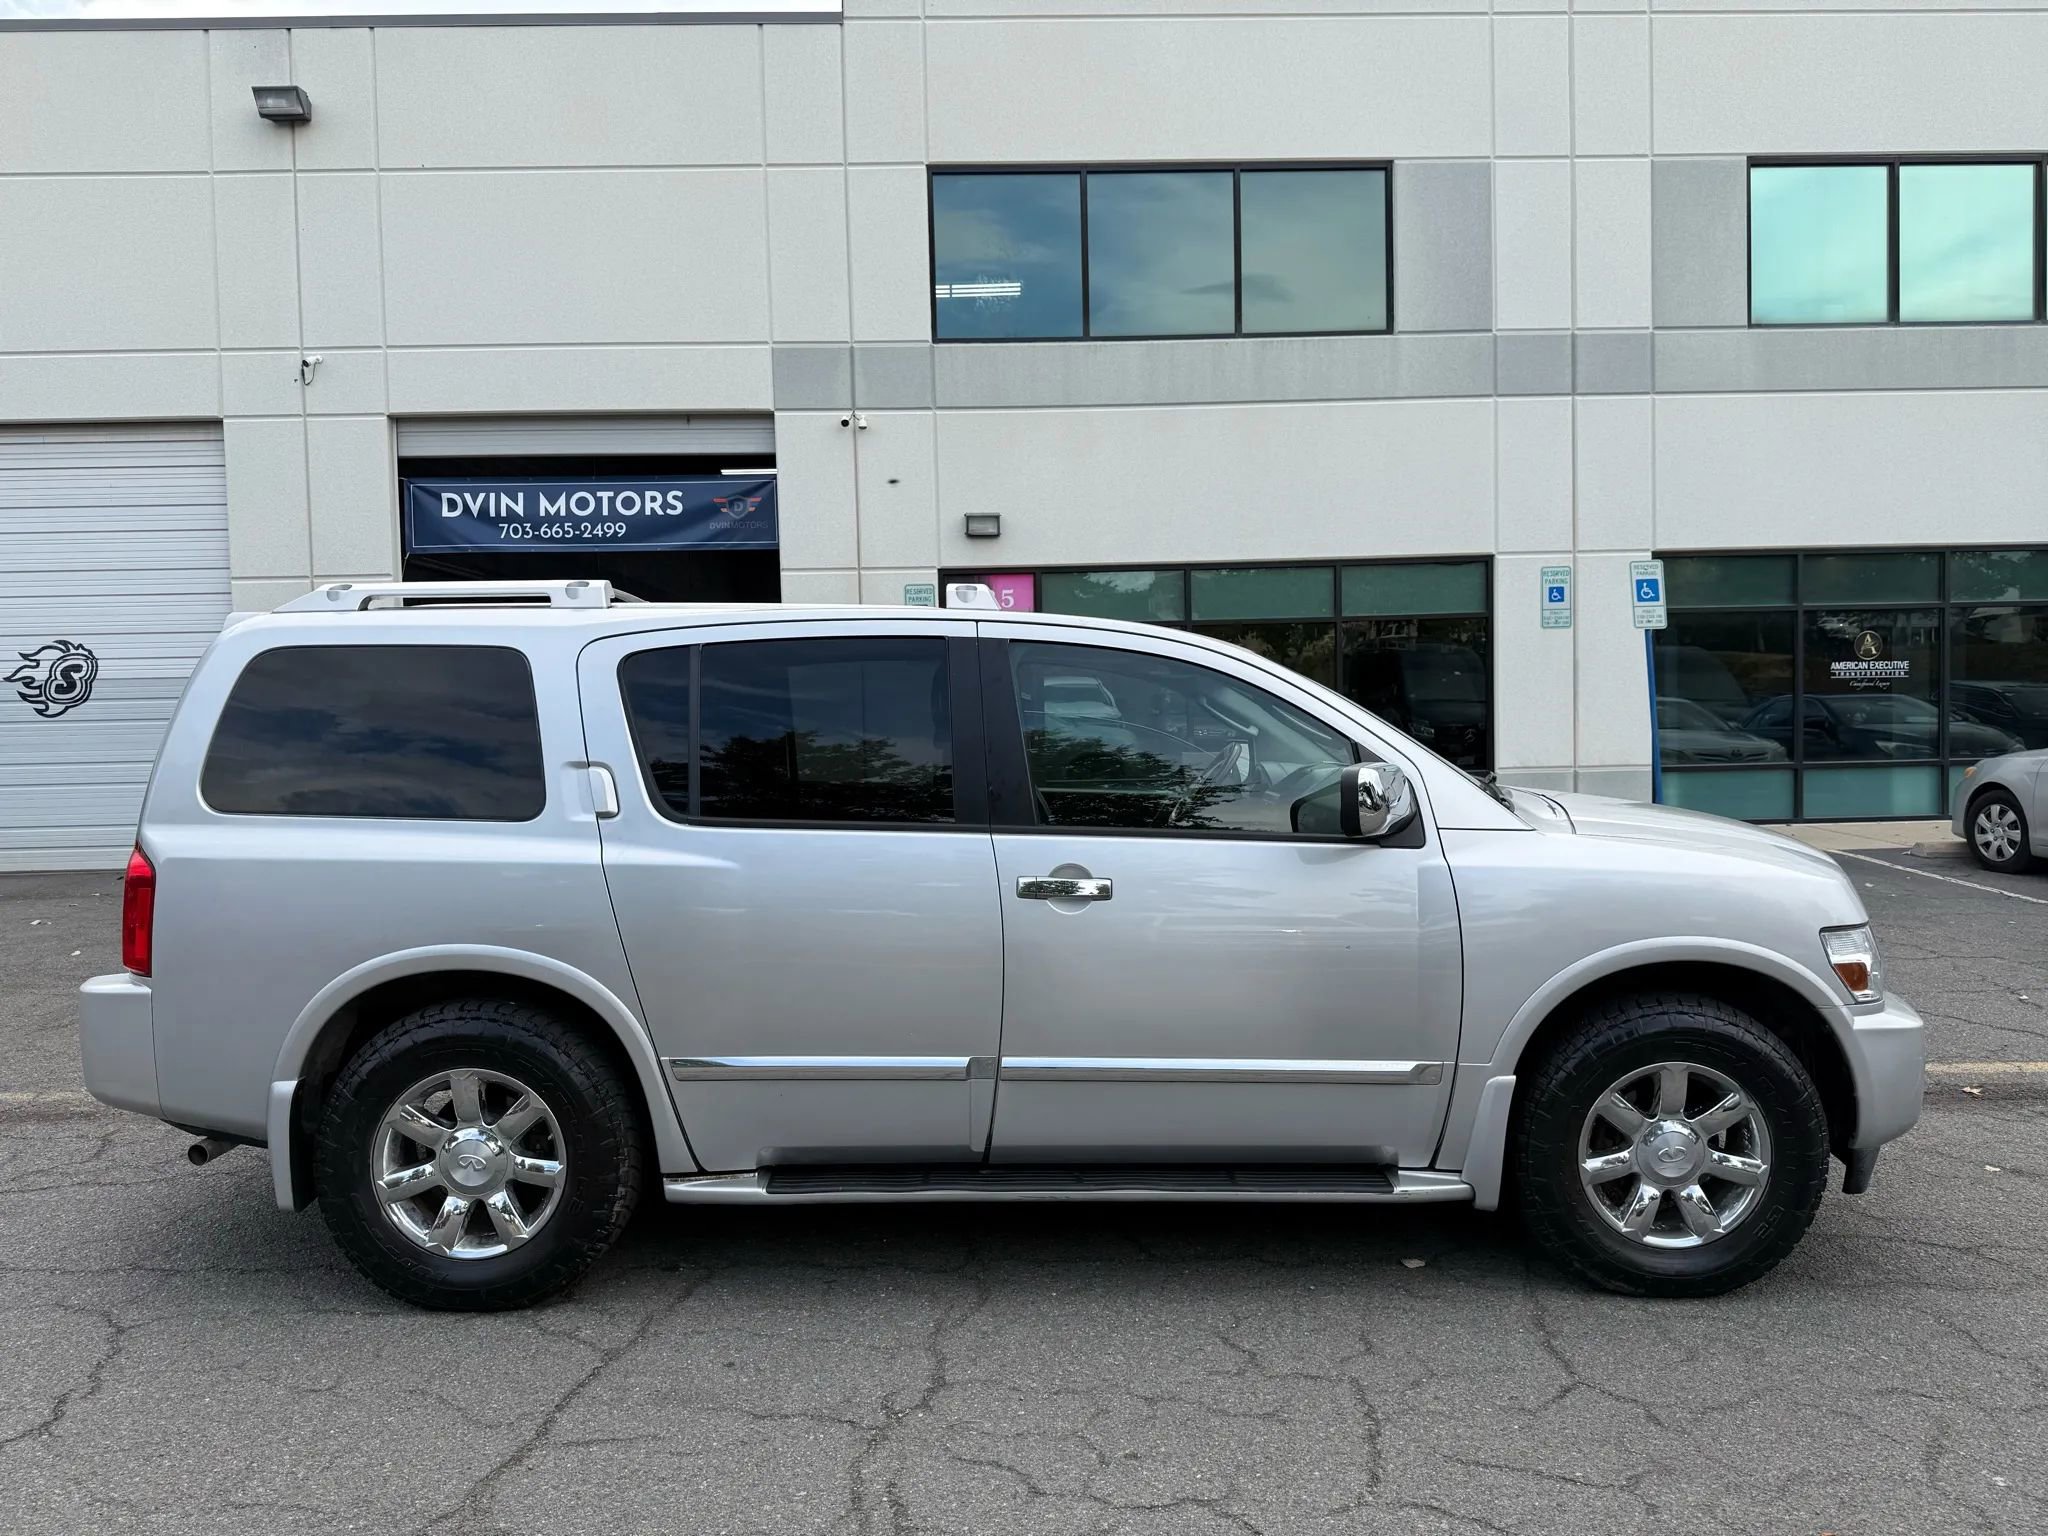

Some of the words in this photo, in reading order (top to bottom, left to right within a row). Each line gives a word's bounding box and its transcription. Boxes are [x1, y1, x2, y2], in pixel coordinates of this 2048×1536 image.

[441, 492, 525, 518] DVIN
[539, 490, 684, 517] MOTORS
[498, 522, 627, 539] 703-665-2499
[906, 587, 933, 595] RESERVED
[1830, 661, 1869, 670] AMERICAN
[1869, 661, 1910, 669] EXECUTIVE
